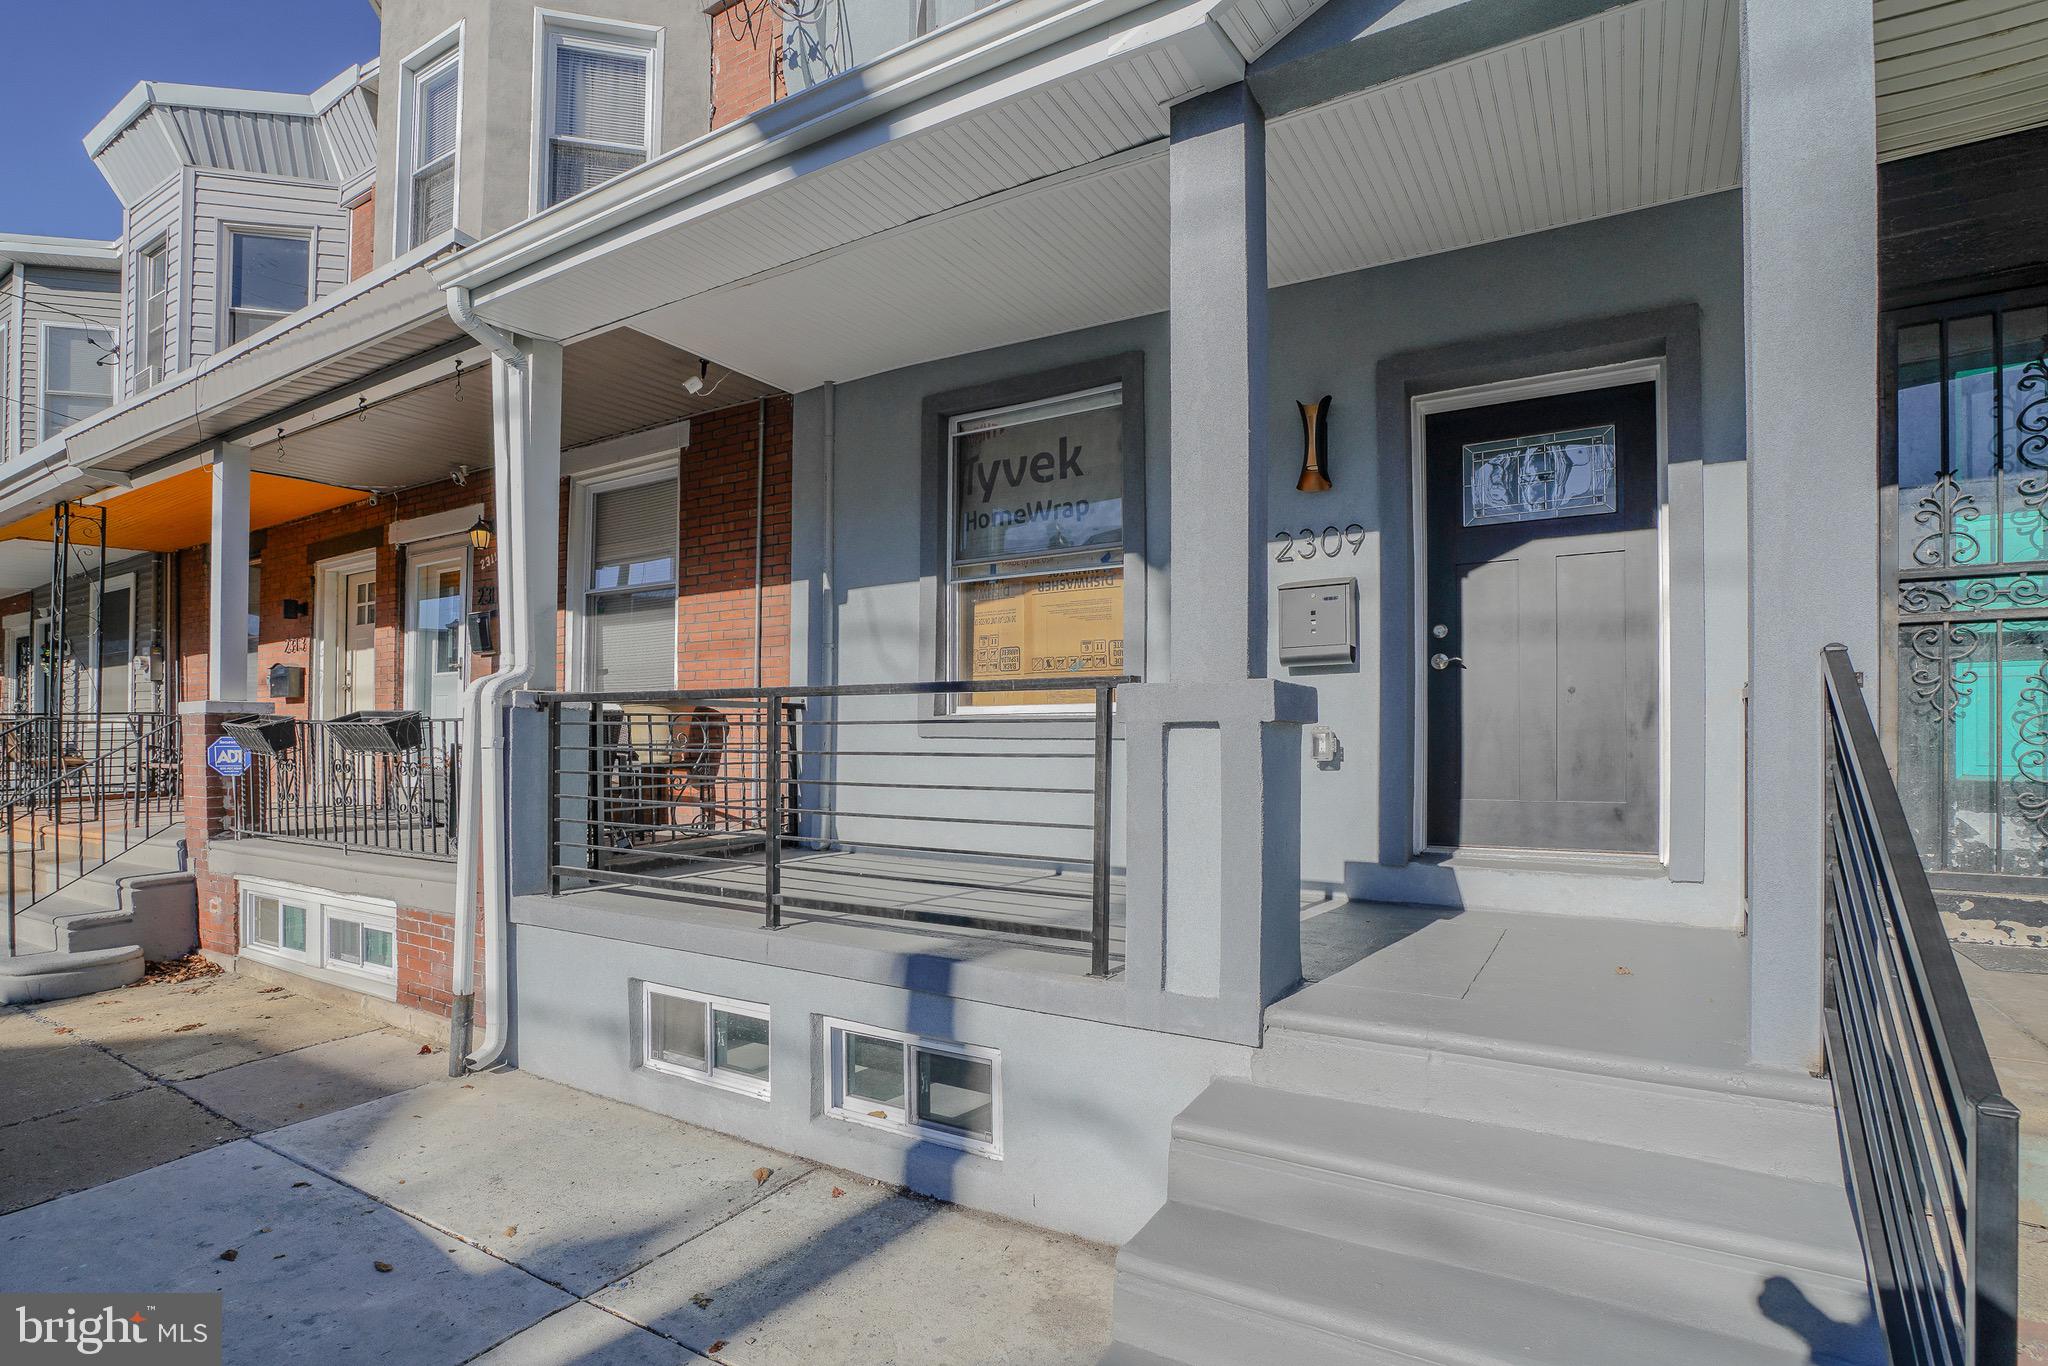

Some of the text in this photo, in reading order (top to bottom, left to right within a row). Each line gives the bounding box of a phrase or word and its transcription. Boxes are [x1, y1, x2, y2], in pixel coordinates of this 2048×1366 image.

[963, 436, 1084, 503] Tyvek
[966, 499, 1090, 532] HomeWrap
[1275, 523, 1366, 562] 2309
[1037, 575, 1114, 592] DISHWASHER
[216, 749, 243, 763] ADT
